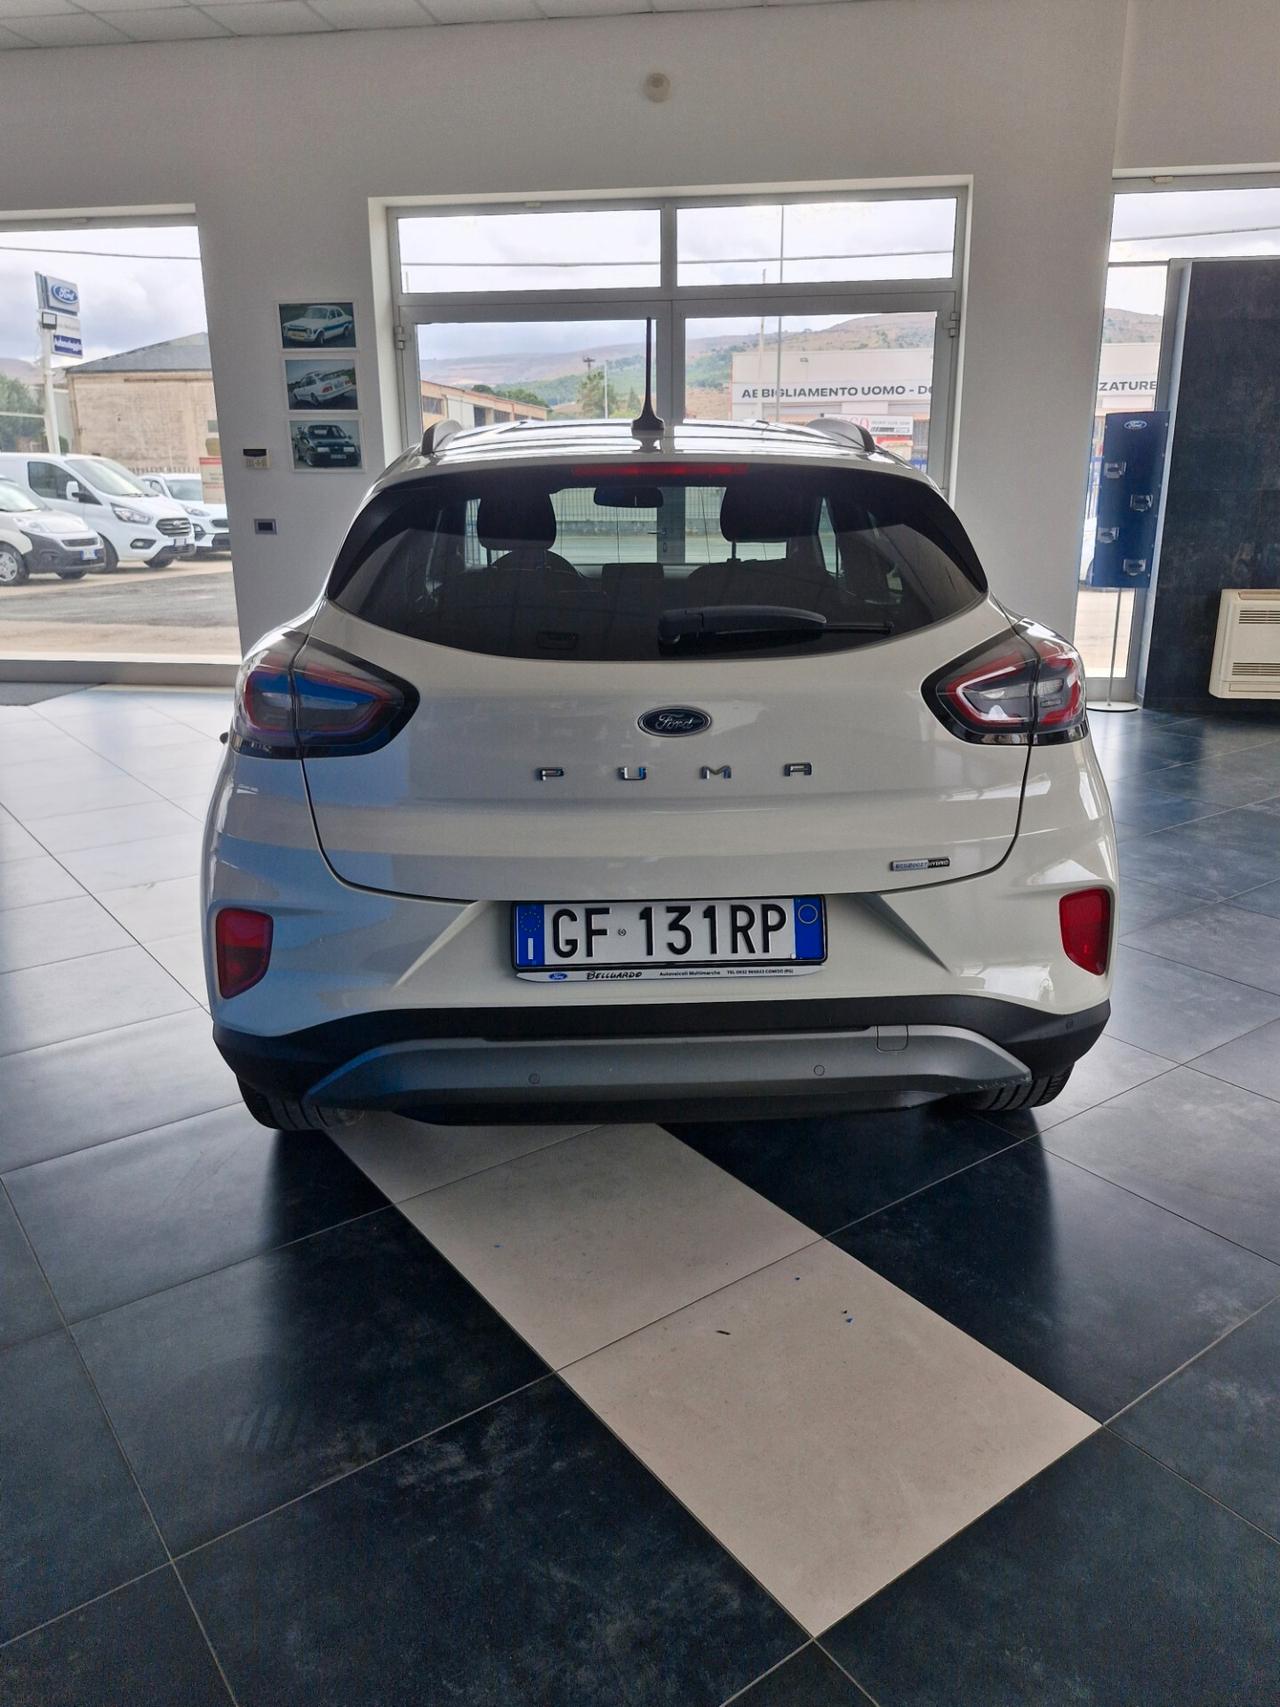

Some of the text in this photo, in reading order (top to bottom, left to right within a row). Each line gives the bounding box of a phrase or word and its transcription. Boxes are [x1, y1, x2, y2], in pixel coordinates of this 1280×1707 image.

[861, 385, 906, 396] UOMO
[537, 762, 812, 781] PUMA
[552, 903, 787, 958] GF 131RP
